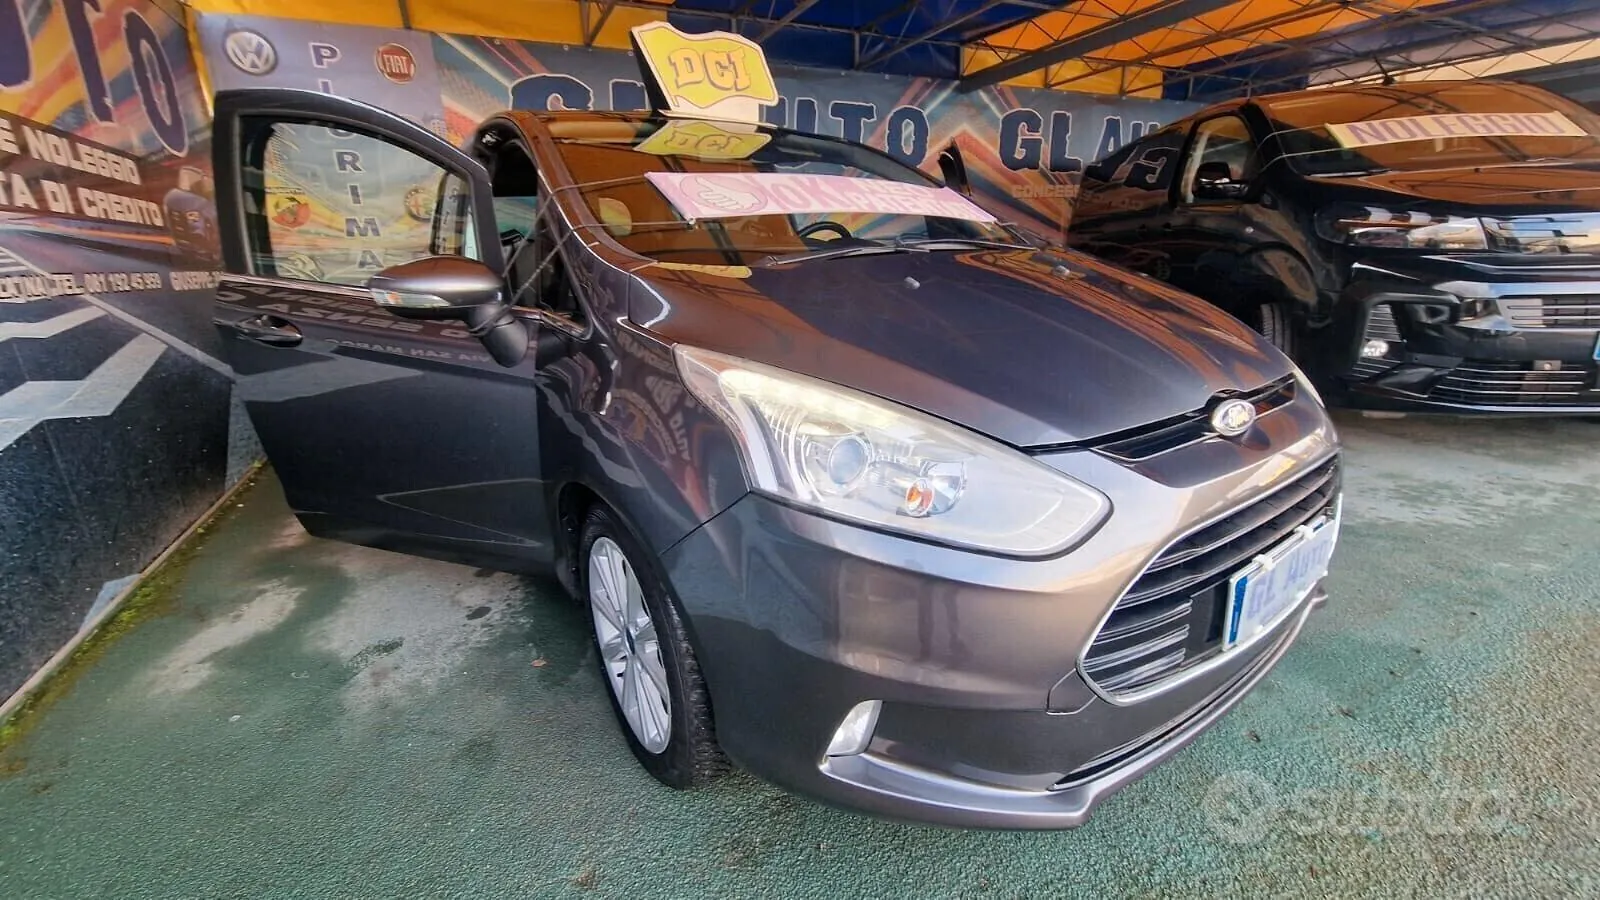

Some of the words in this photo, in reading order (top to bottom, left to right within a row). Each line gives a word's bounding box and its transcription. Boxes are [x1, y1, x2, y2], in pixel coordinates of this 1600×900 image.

[383, 53, 409, 74] FIAT
[668, 47, 752, 91] DCI
[764, 95, 930, 168] UTO
[1000, 107, 1161, 172] GLA
[1346, 113, 1567, 144] NOLEGGIO
[21, 125, 142, 186] NOLEGGIO
[40, 179, 76, 215] DI
[77, 186, 165, 228] CREDITO
